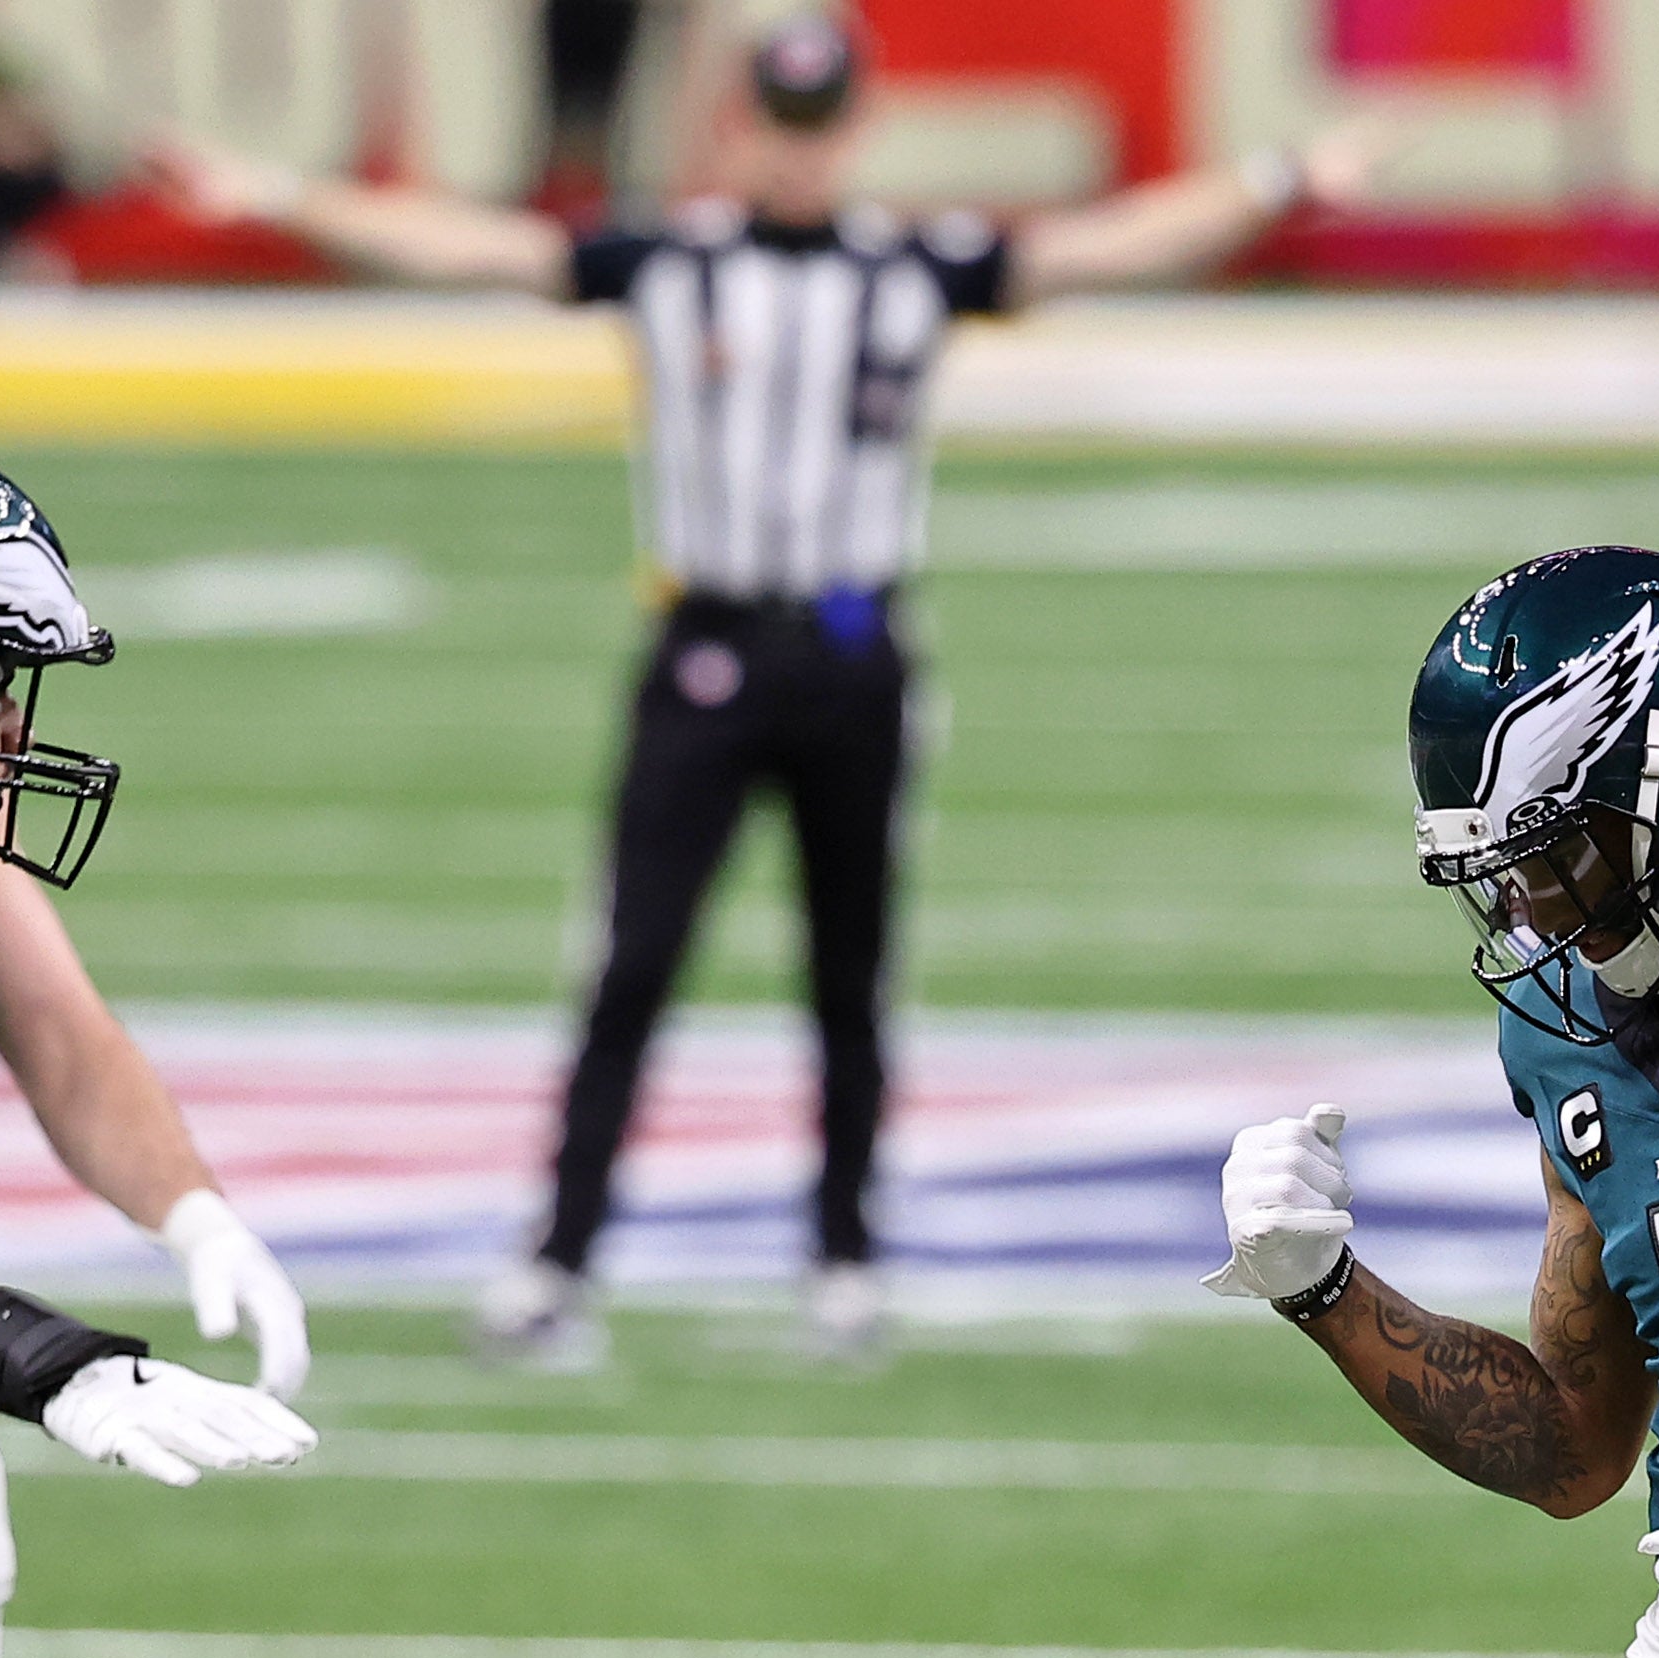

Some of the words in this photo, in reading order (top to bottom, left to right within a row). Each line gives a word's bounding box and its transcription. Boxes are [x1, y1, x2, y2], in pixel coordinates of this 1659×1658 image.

[1509, 804, 1559, 834] OAKLEY
[1559, 1090, 1602, 1158] C
[1322, 1287, 1342, 1305] Big
